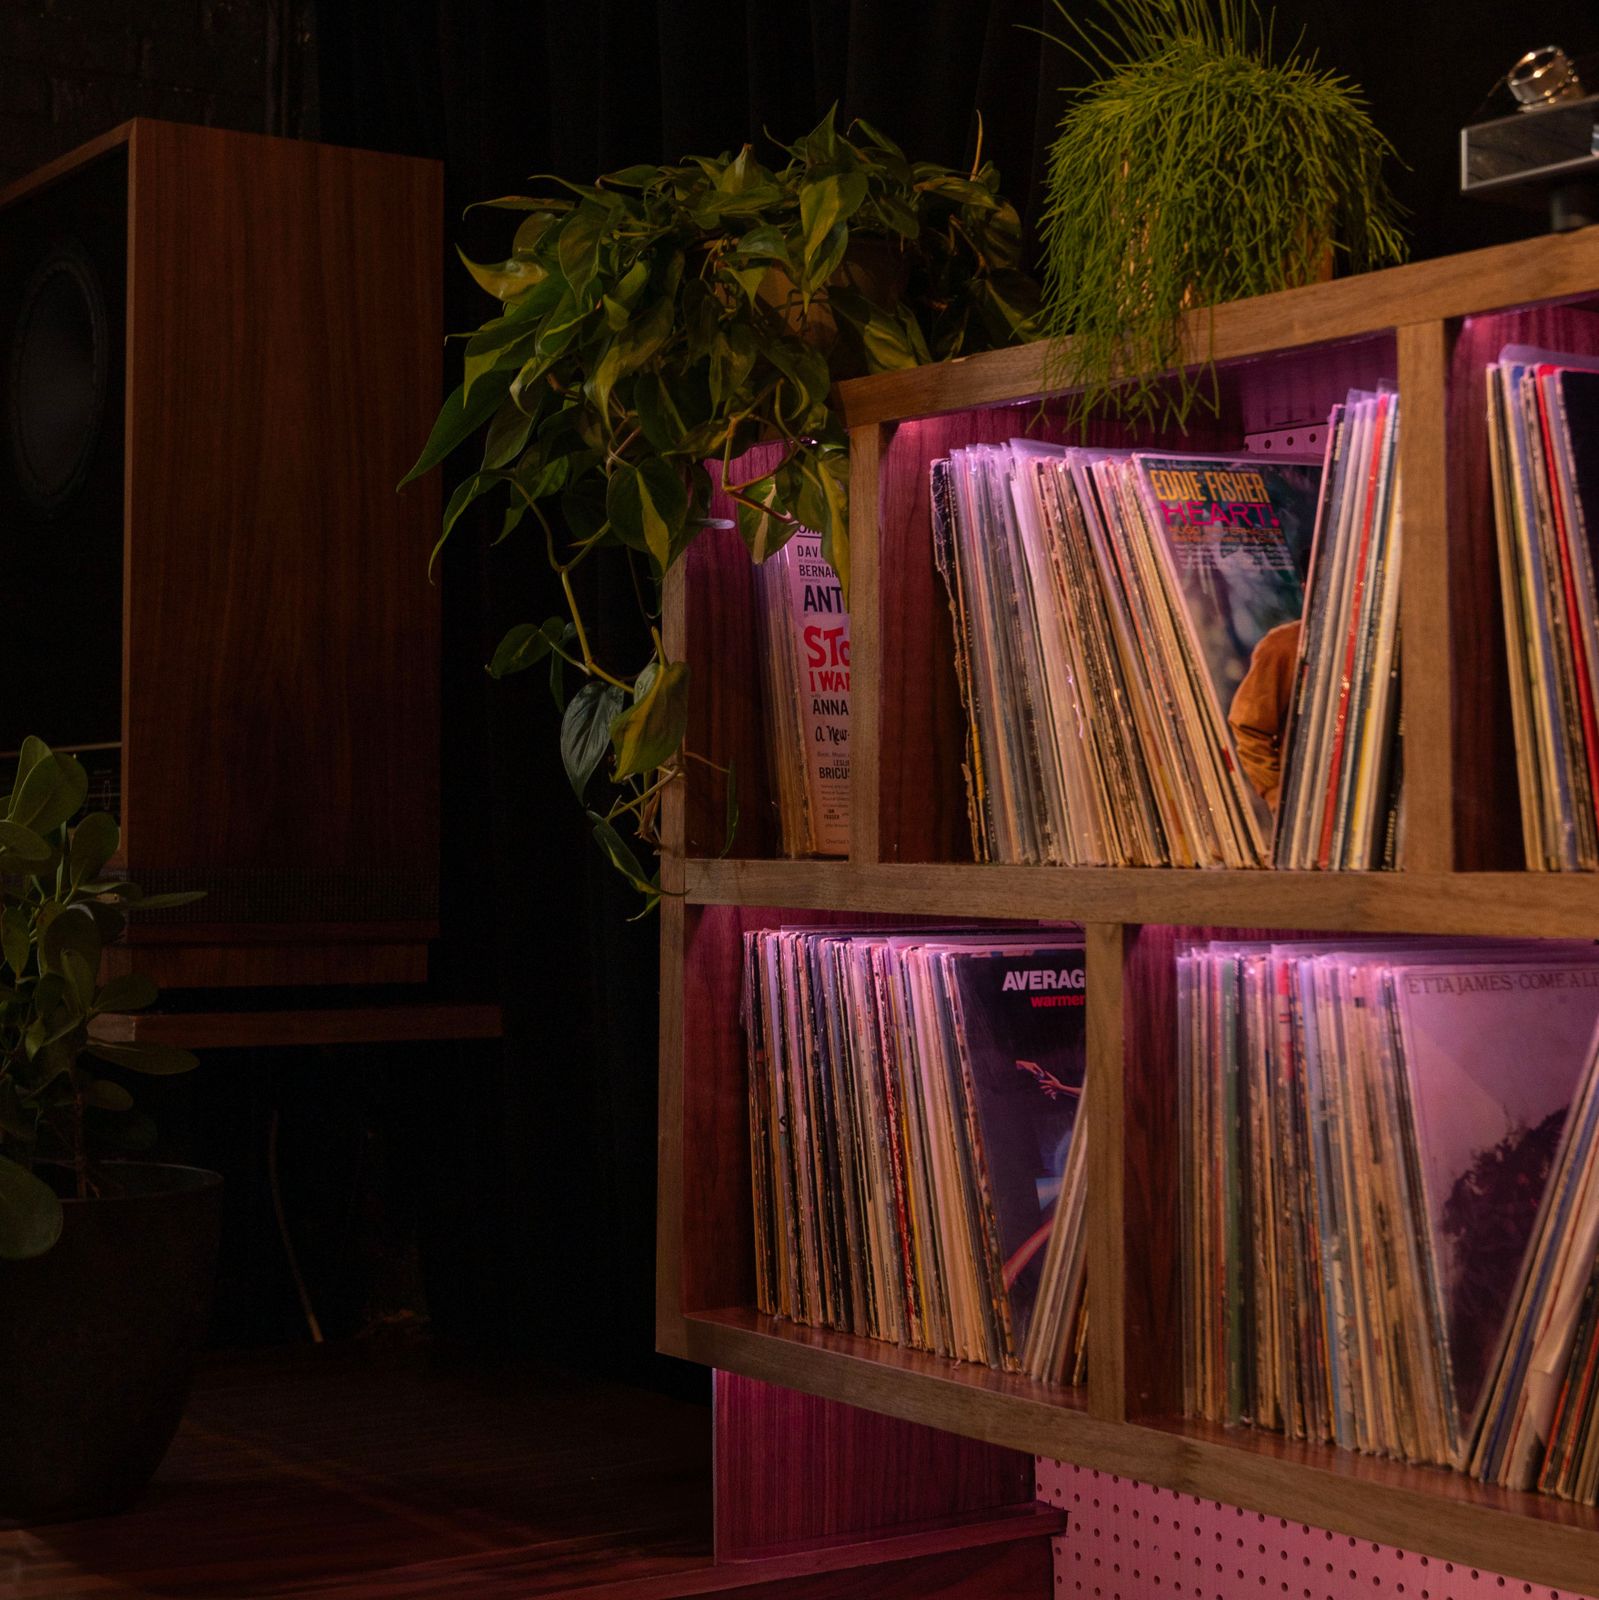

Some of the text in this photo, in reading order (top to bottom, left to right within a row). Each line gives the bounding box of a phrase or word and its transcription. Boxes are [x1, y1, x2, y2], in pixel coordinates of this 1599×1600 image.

[1150, 469, 1271, 503] EDDIE FISHER
[1159, 501, 1281, 528] HEART!
[804, 585, 842, 613] ANT
[809, 671, 816, 692] I
[813, 699, 849, 716] ANNA
[1002, 968, 1085, 991] AVERAG
[1409, 977, 1455, 994] ETTA
[1456, 975, 1513, 995] JAMES
[1519, 973, 1568, 990] COME
[1030, 994, 1085, 1008] warmer
